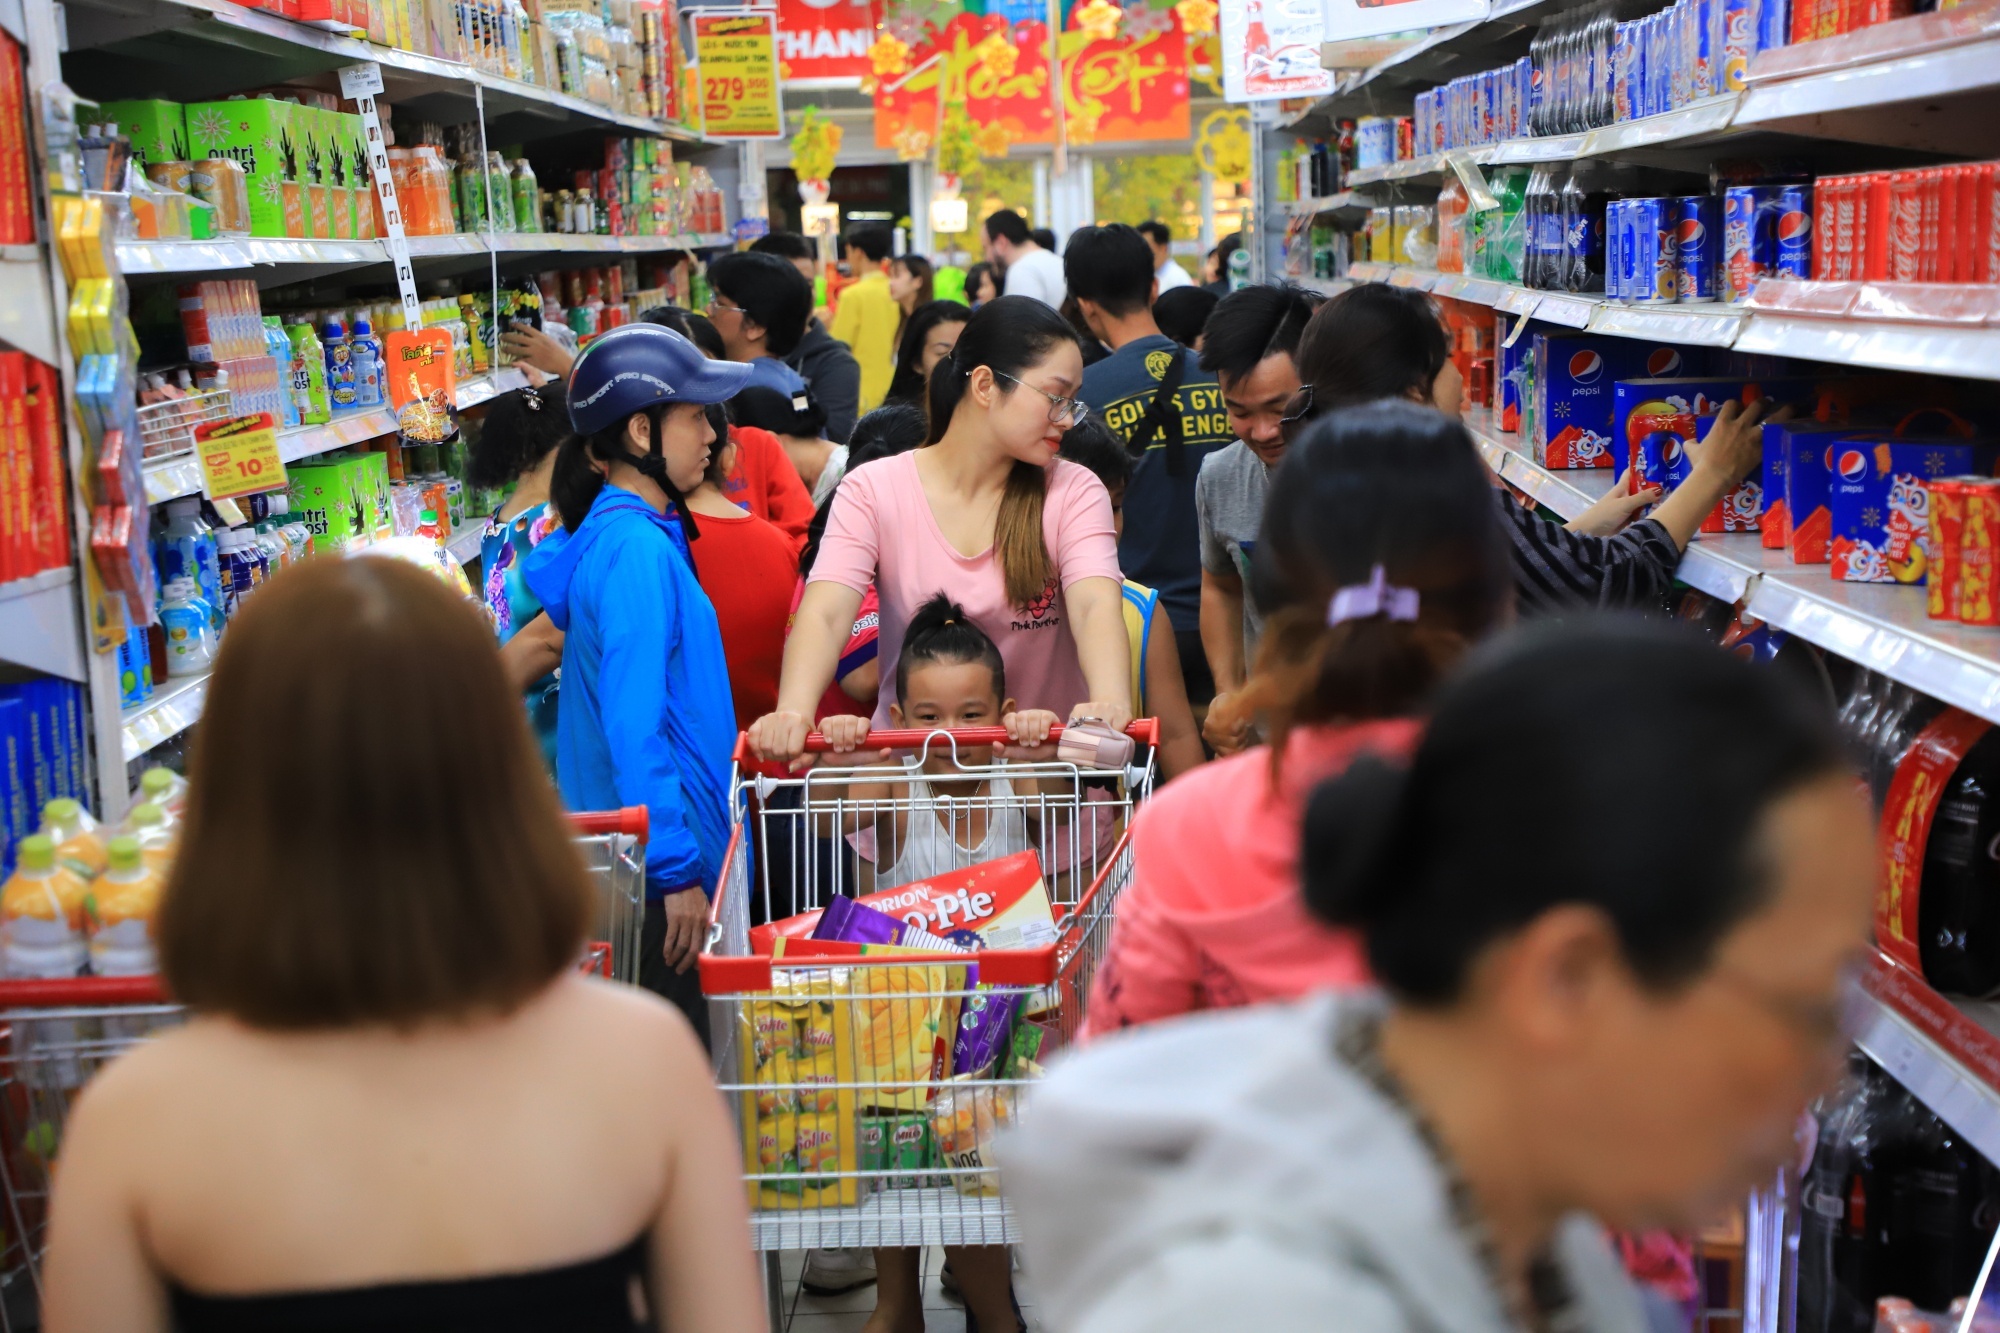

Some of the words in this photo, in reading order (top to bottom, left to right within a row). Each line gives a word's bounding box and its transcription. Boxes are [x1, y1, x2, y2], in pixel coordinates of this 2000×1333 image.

[706, 77, 744, 101] 279
[1572, 386, 1600, 397] pepsi
[236, 458, 263, 478] 10
[1841, 485, 1865, 494] pepsi
[1011, 620, 1031, 631] Pink
[868, 888, 930, 913] ORION
[895, 1128, 921, 1142] MILO
